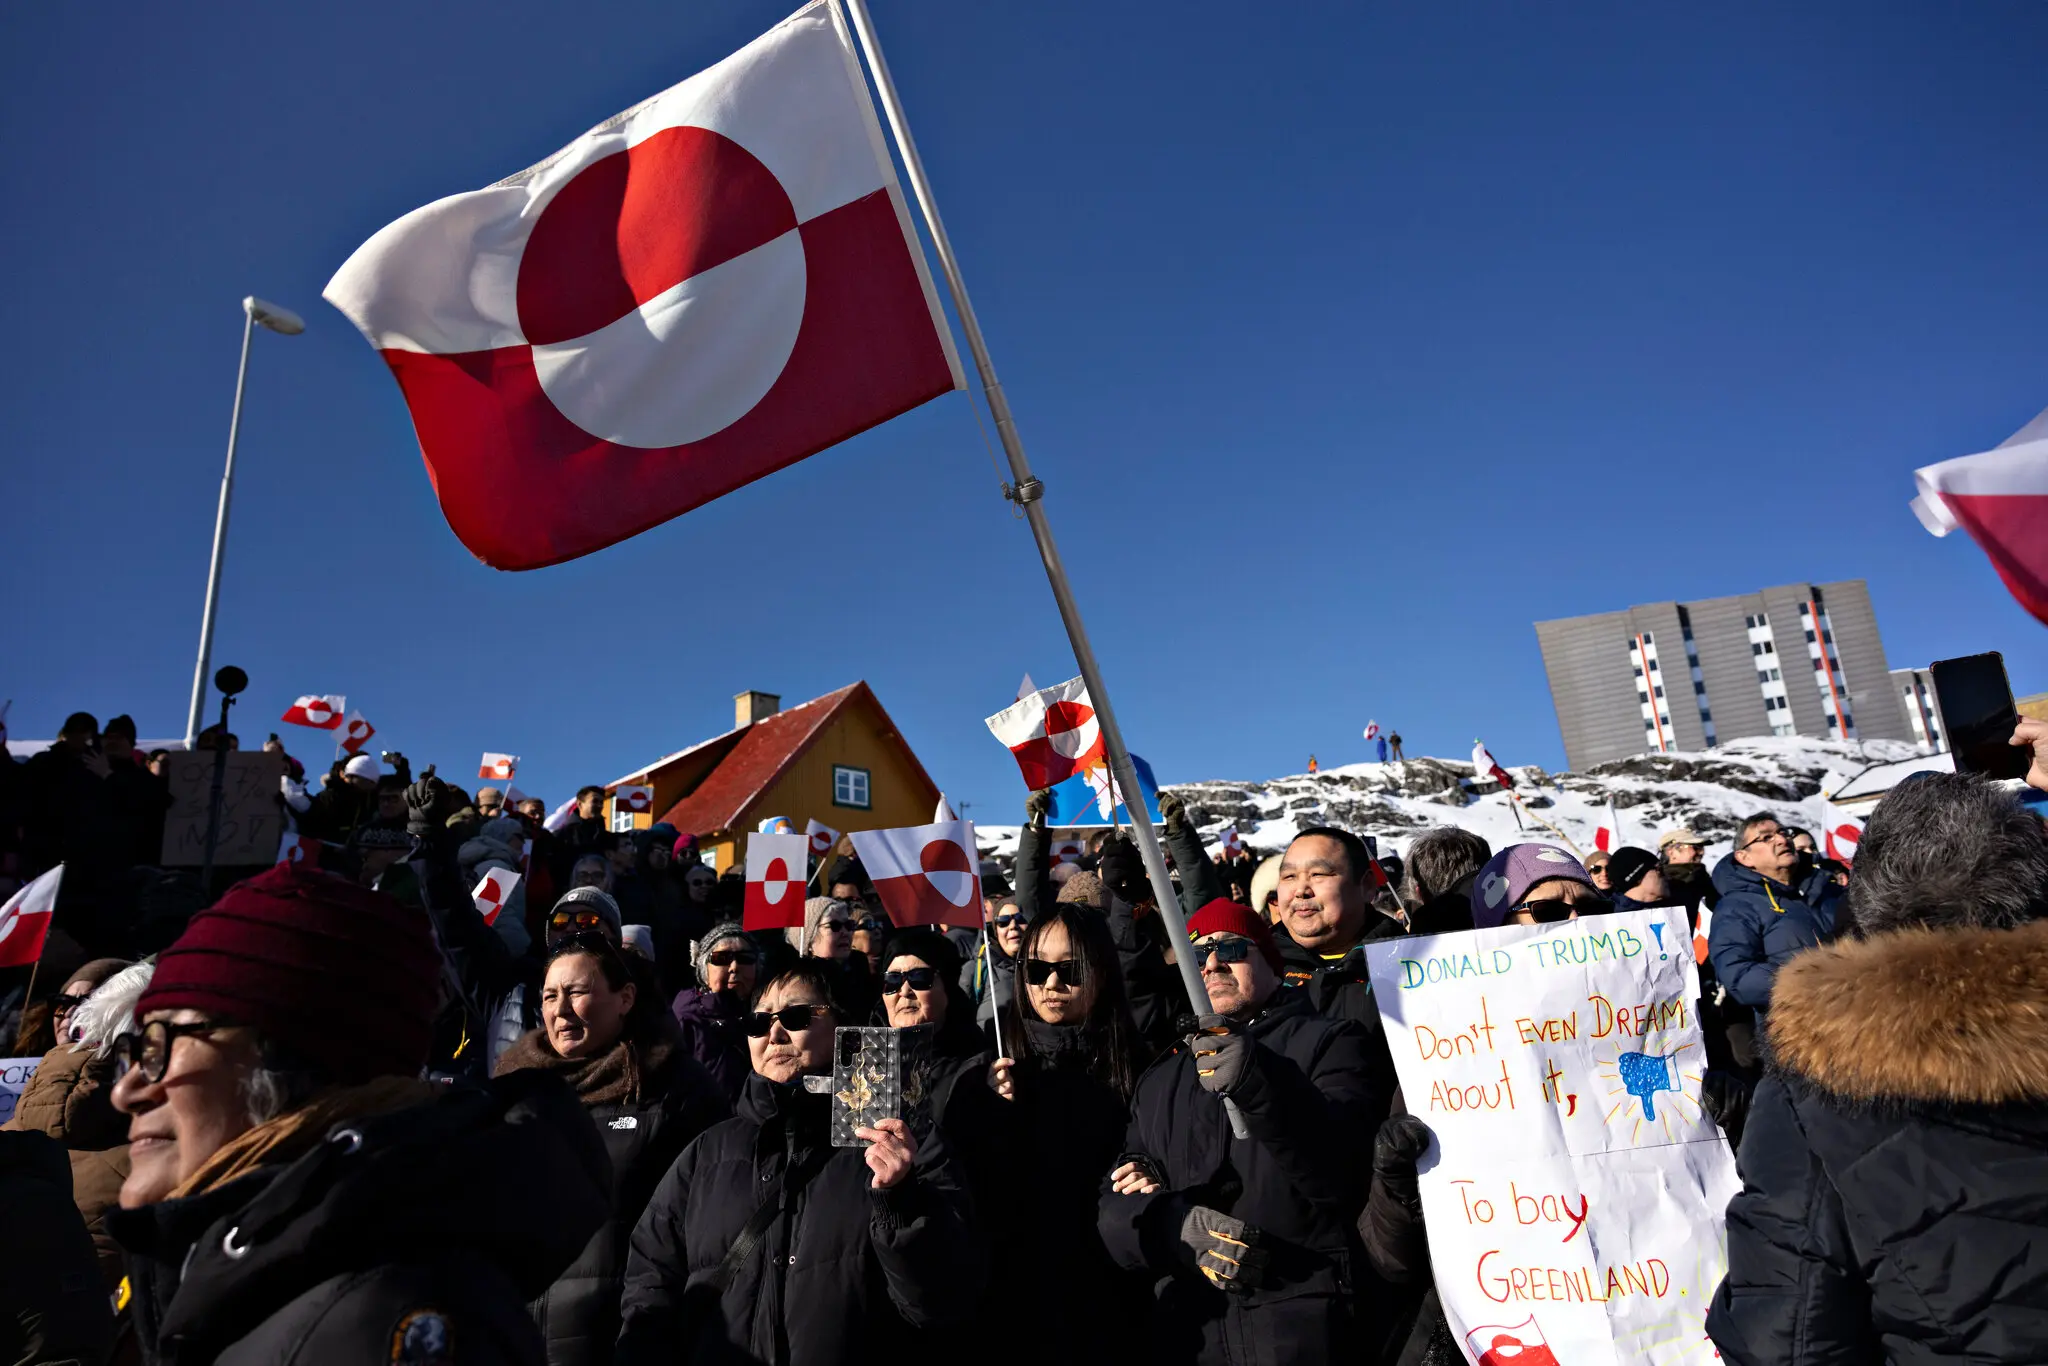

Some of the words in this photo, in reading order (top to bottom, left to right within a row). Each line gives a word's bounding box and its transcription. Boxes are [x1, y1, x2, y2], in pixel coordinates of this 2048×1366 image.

[184, 793, 237, 817] SY
[1400, 949, 1512, 989] DONALD
[1414, 996, 1496, 1061] Don't
[1515, 1010, 1577, 1046] EVEN
[1588, 995, 1686, 1038] DREAM
[1542, 1058, 1577, 1117] it,
[1450, 1180, 1494, 1225] To
[1511, 1181, 1589, 1243] bay
